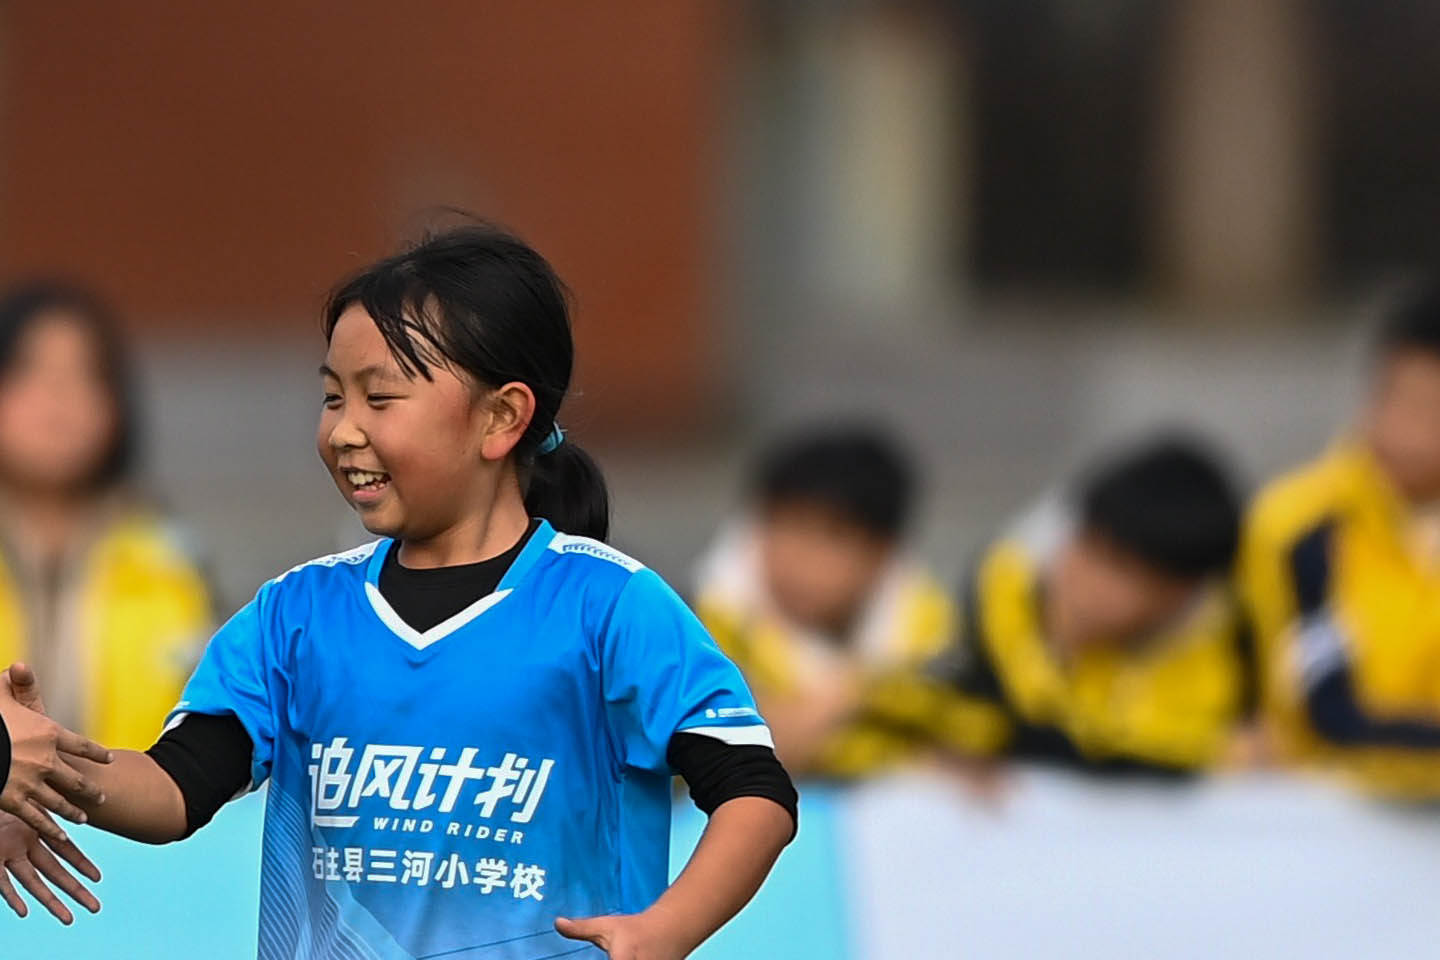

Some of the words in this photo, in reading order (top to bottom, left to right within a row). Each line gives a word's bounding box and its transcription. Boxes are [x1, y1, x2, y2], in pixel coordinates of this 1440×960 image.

[309, 737, 555, 828] 追风计划
[373, 817, 434, 833] WIND
[446, 822, 525, 845] RIDER
